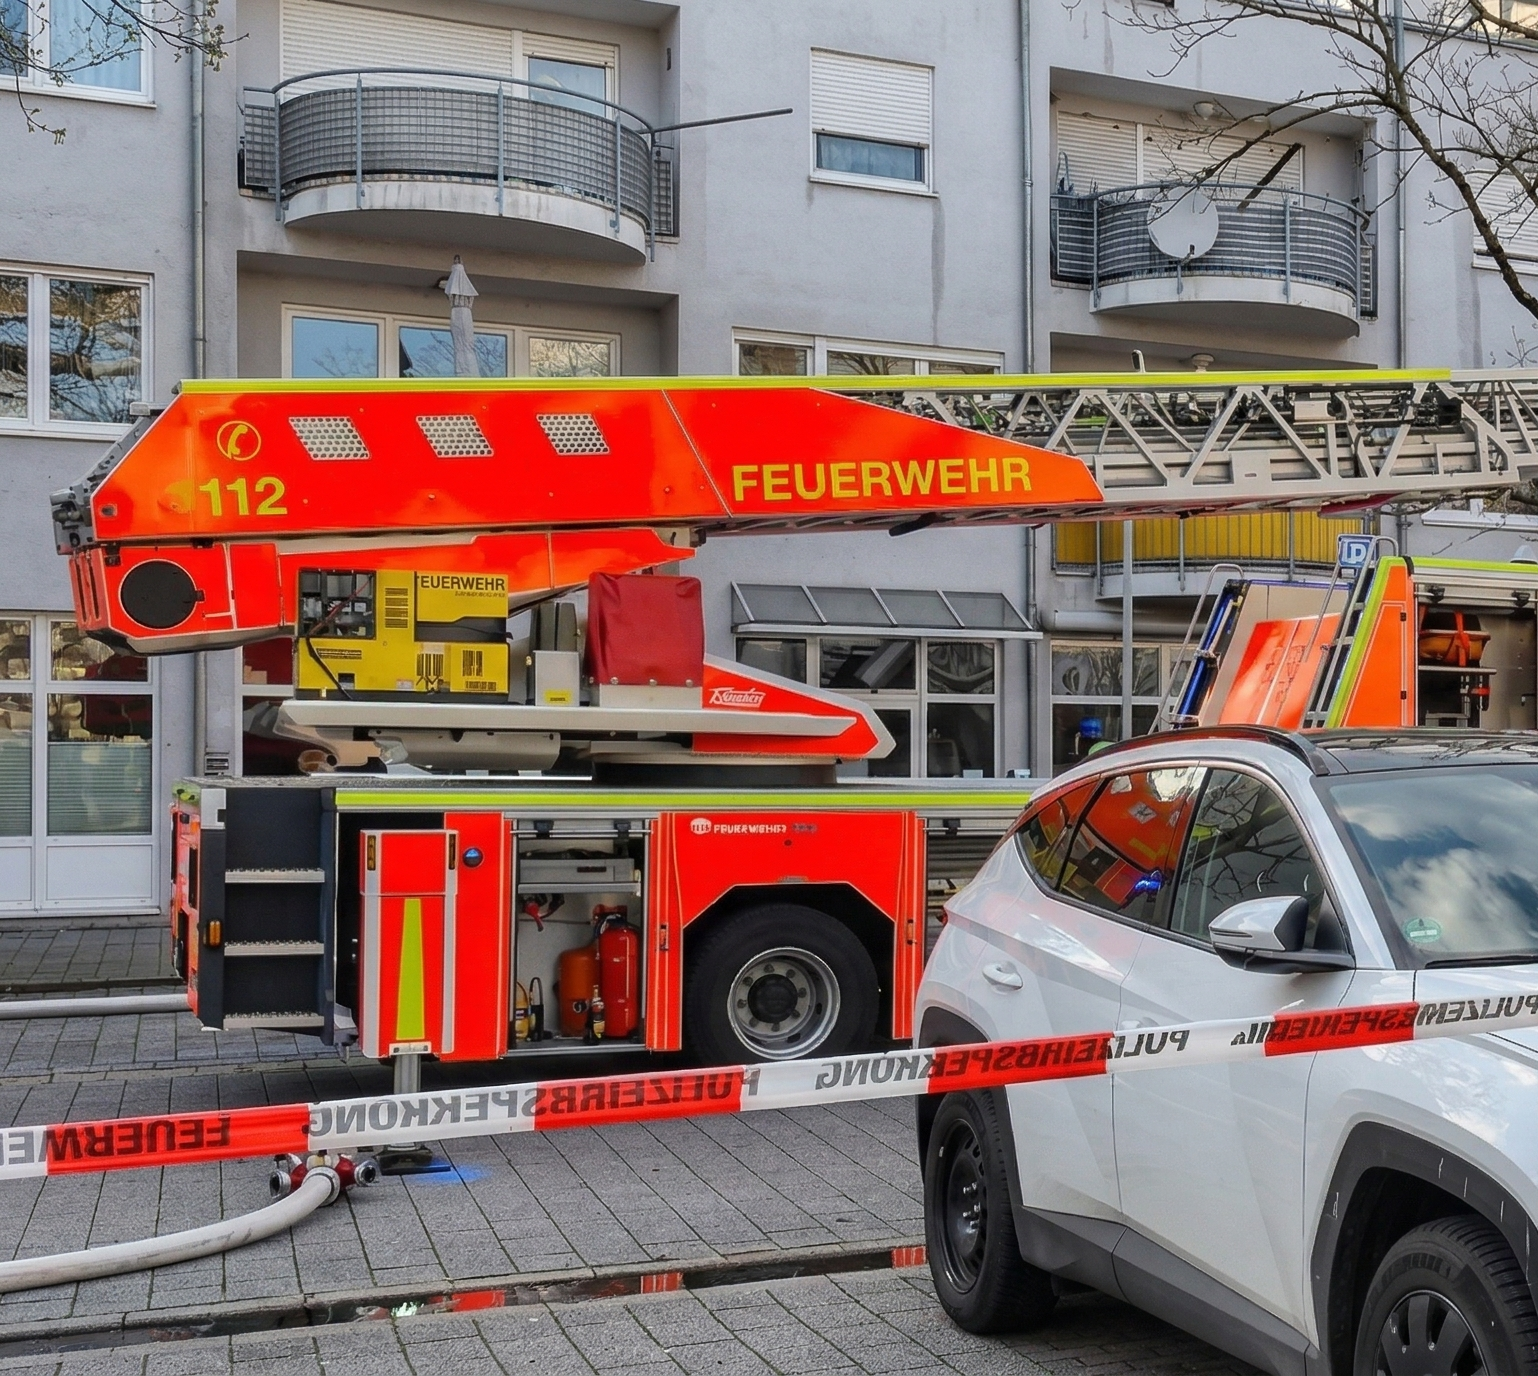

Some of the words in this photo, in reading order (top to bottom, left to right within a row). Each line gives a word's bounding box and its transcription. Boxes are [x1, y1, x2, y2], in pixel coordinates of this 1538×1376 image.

[199, 476, 288, 517] 112
[732, 457, 1032, 502] FEUERWEHR
[418, 575, 505, 591] EUERWEHR
[0, 1116, 231, 1165] FEUERWE
